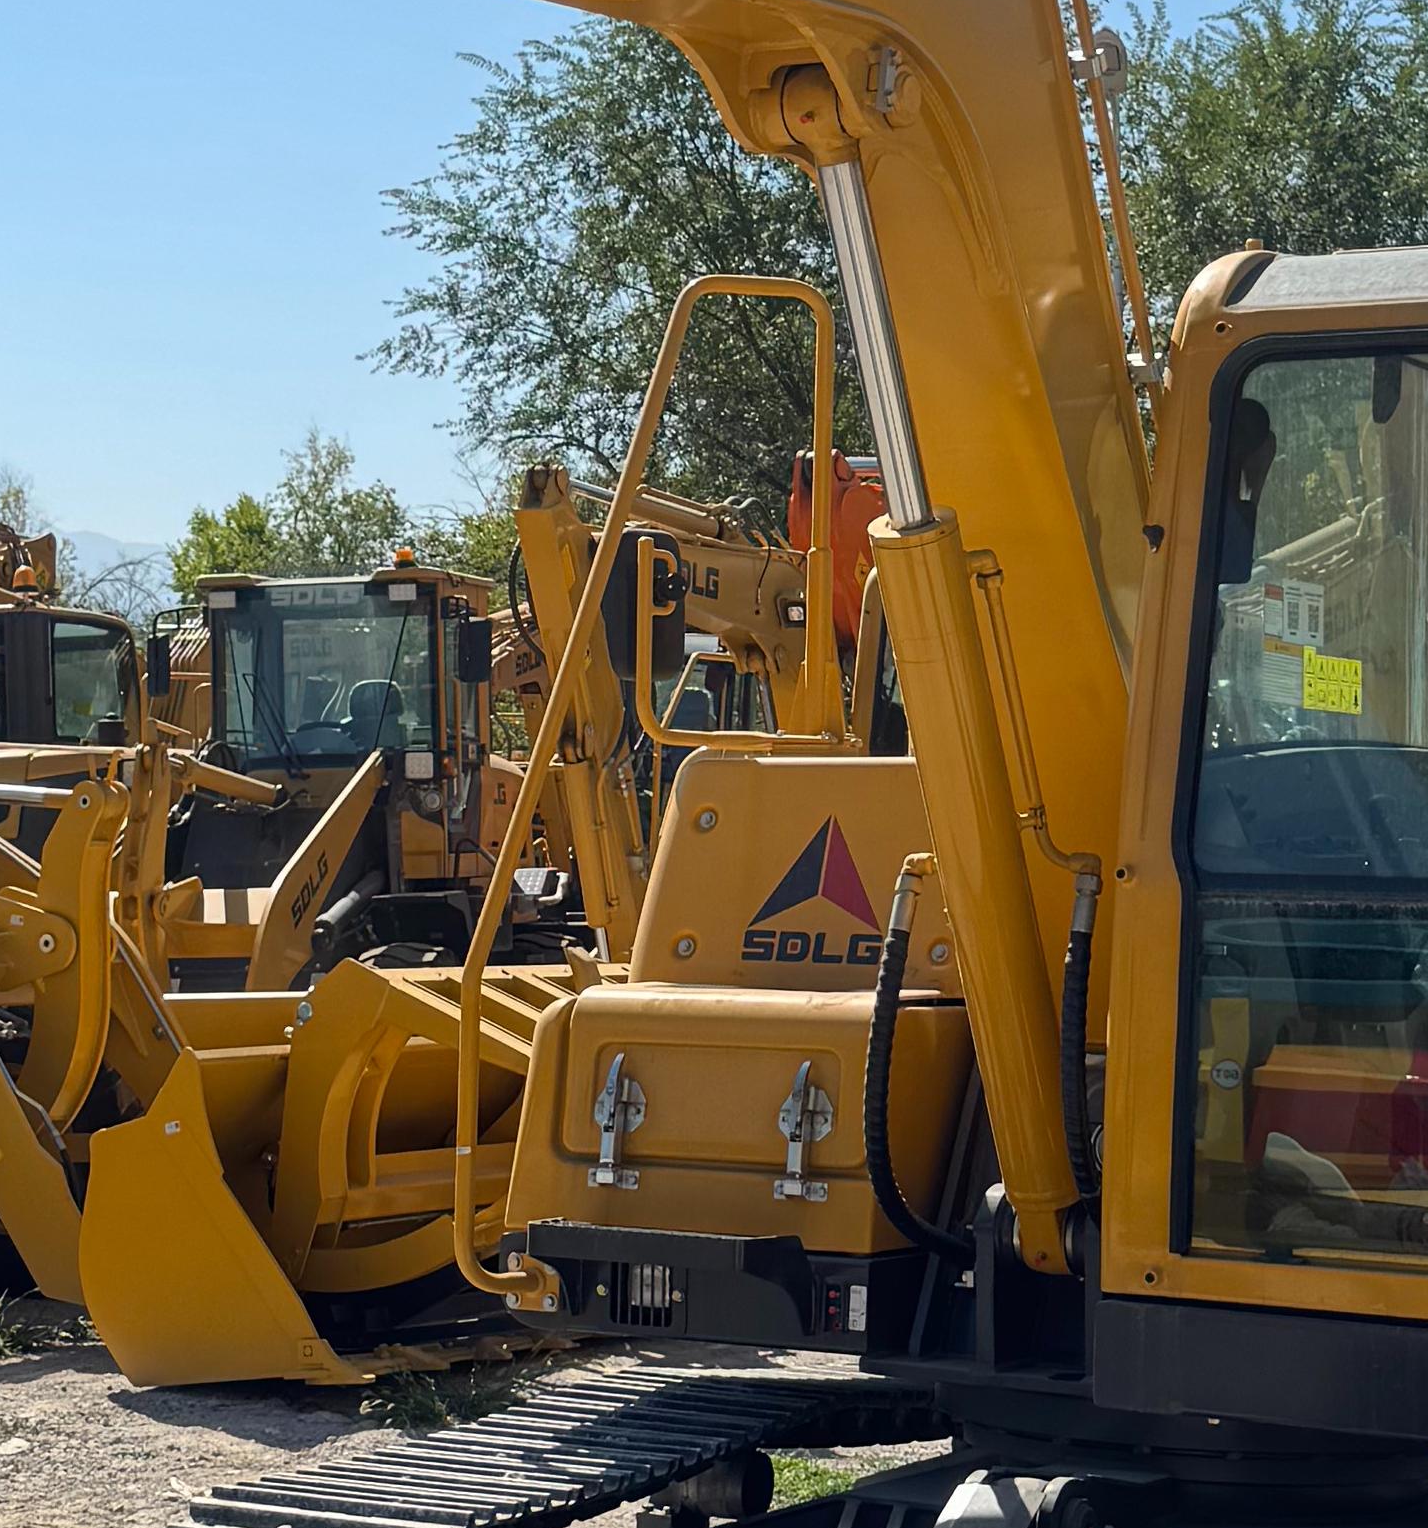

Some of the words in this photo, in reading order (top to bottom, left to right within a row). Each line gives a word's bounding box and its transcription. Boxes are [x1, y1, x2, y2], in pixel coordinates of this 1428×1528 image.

[270, 583, 362, 607] SDLG
[290, 849, 329, 931] SDLG
[741, 929, 885, 966] SDLG
